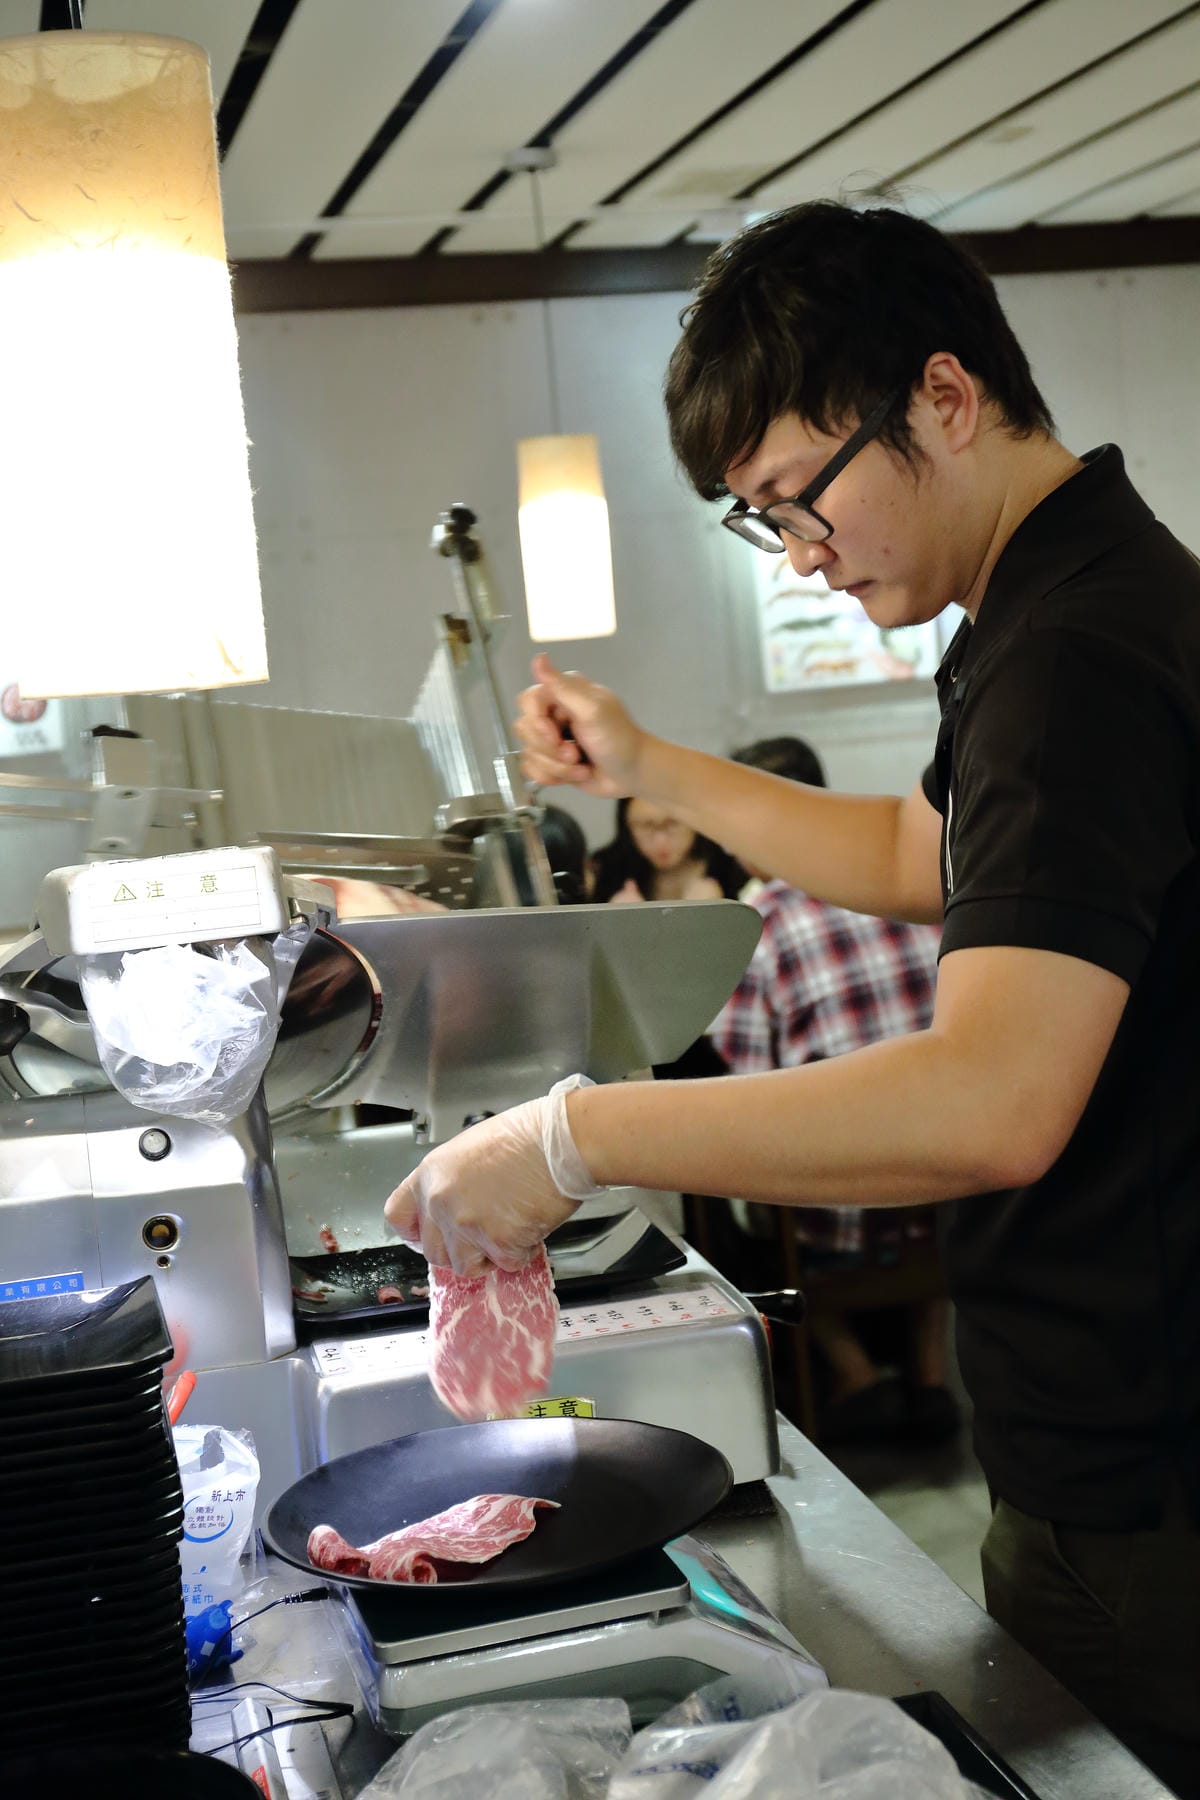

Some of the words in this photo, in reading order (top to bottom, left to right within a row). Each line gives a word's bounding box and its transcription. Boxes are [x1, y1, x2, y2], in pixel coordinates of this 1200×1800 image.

[147, 874, 219, 899] 注意
[528, 1400, 579, 1418] 注意
[211, 1489, 246, 1502] 新上市
